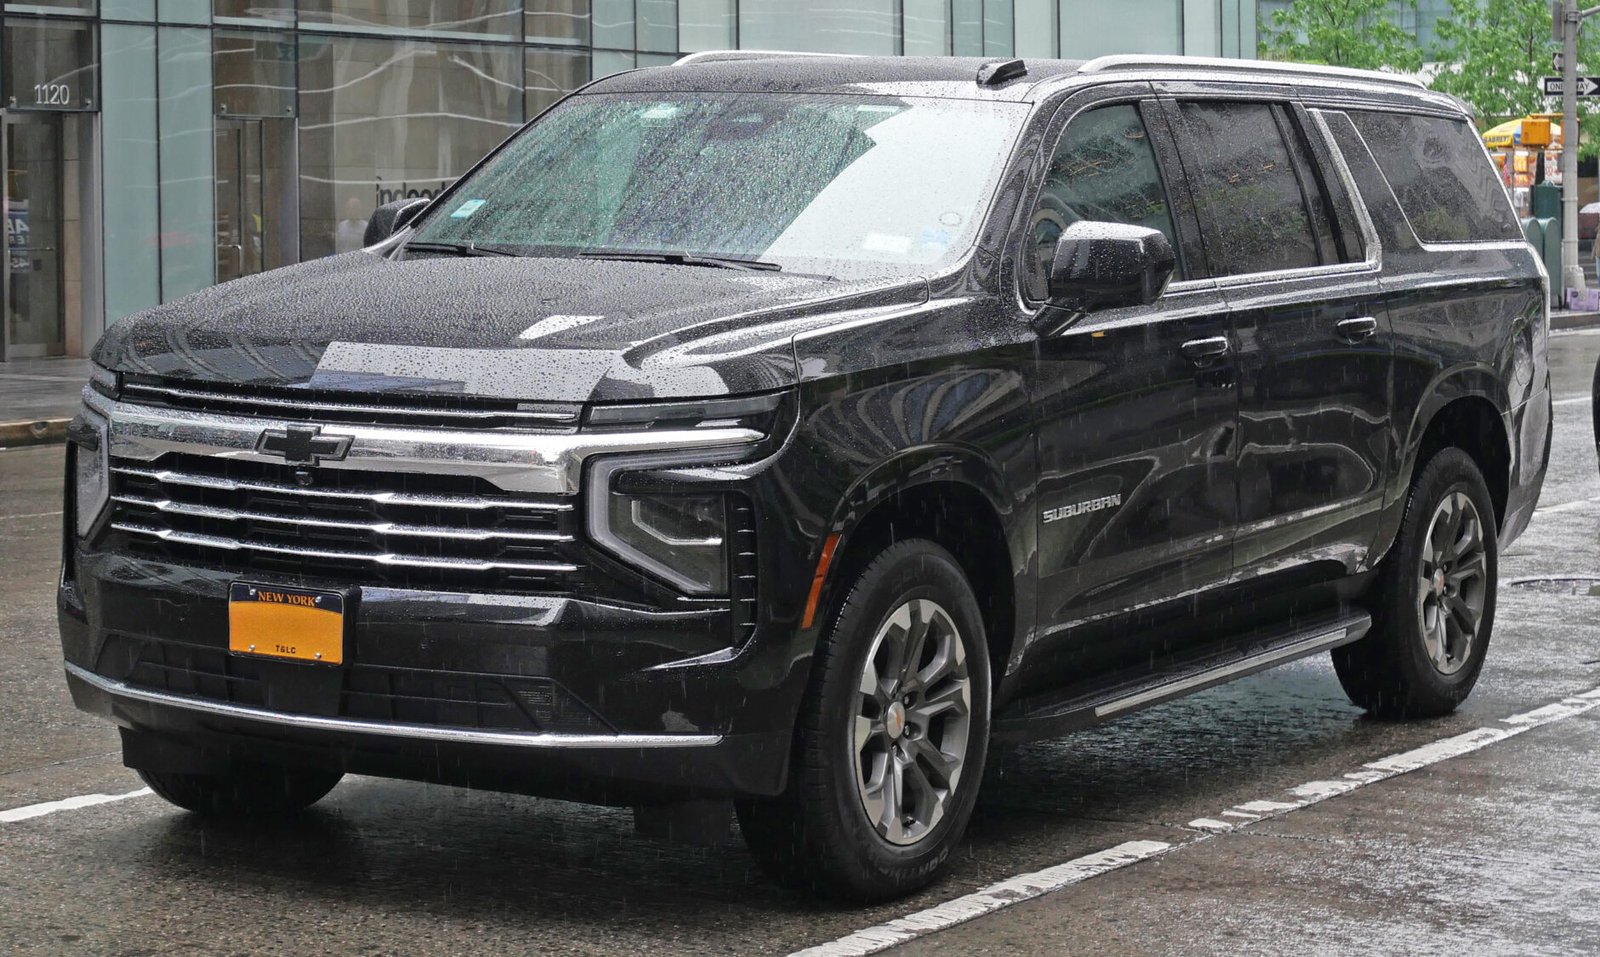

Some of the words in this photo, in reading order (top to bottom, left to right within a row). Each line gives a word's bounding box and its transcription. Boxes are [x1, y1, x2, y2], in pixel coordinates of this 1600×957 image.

[34, 84, 70, 105] 1120
[1043, 493, 1121, 524] SUBURBAN
[257, 591, 284, 603] NEW
[286, 594, 317, 607] YORK
[275, 644, 296, 654] T&LC
